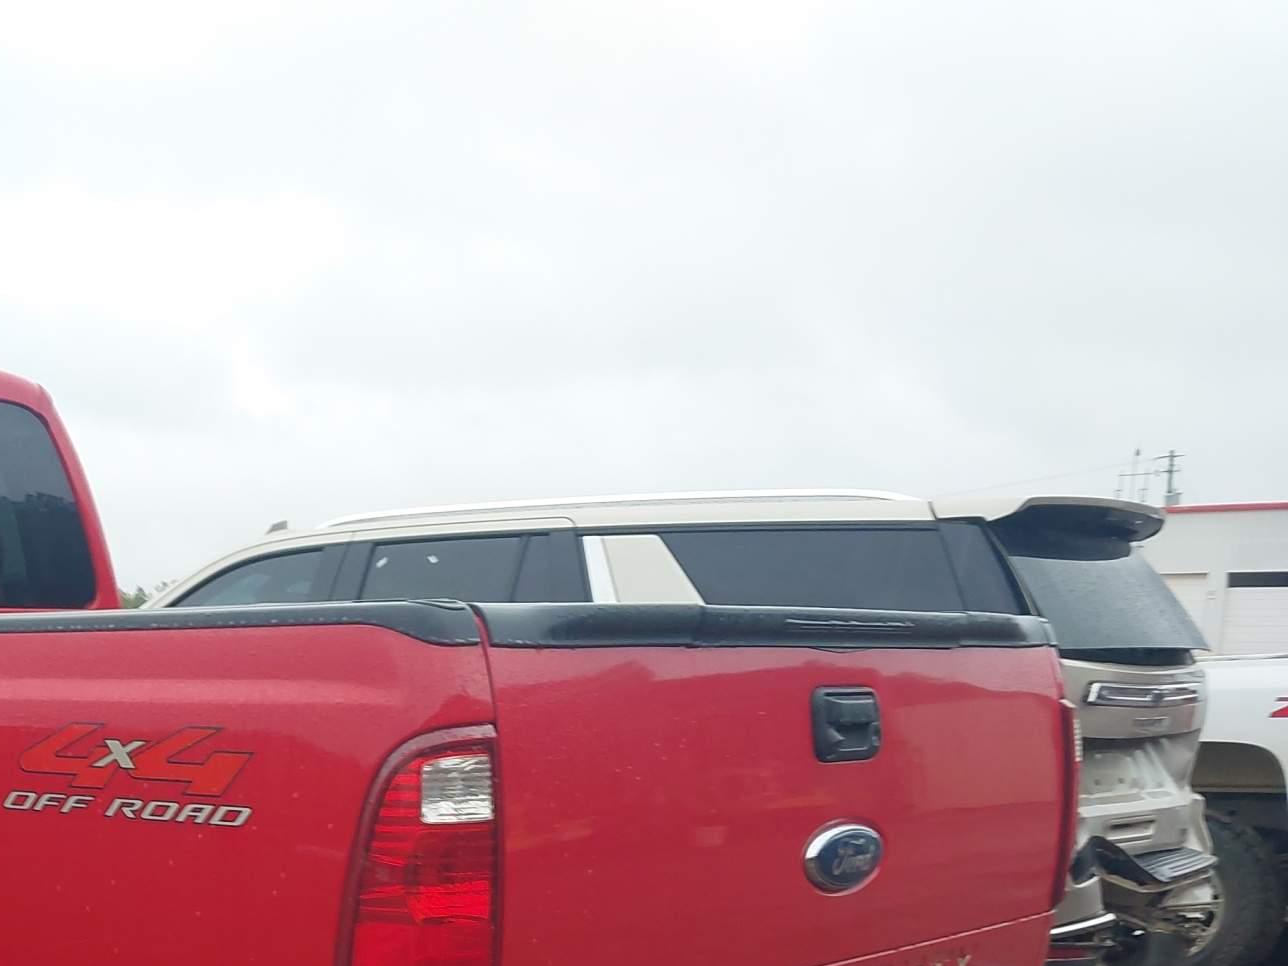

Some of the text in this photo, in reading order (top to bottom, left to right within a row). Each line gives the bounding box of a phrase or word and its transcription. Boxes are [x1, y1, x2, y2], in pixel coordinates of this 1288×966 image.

[2, 789, 253, 828] OFF ROAD
[831, 838, 874, 875] Ford
